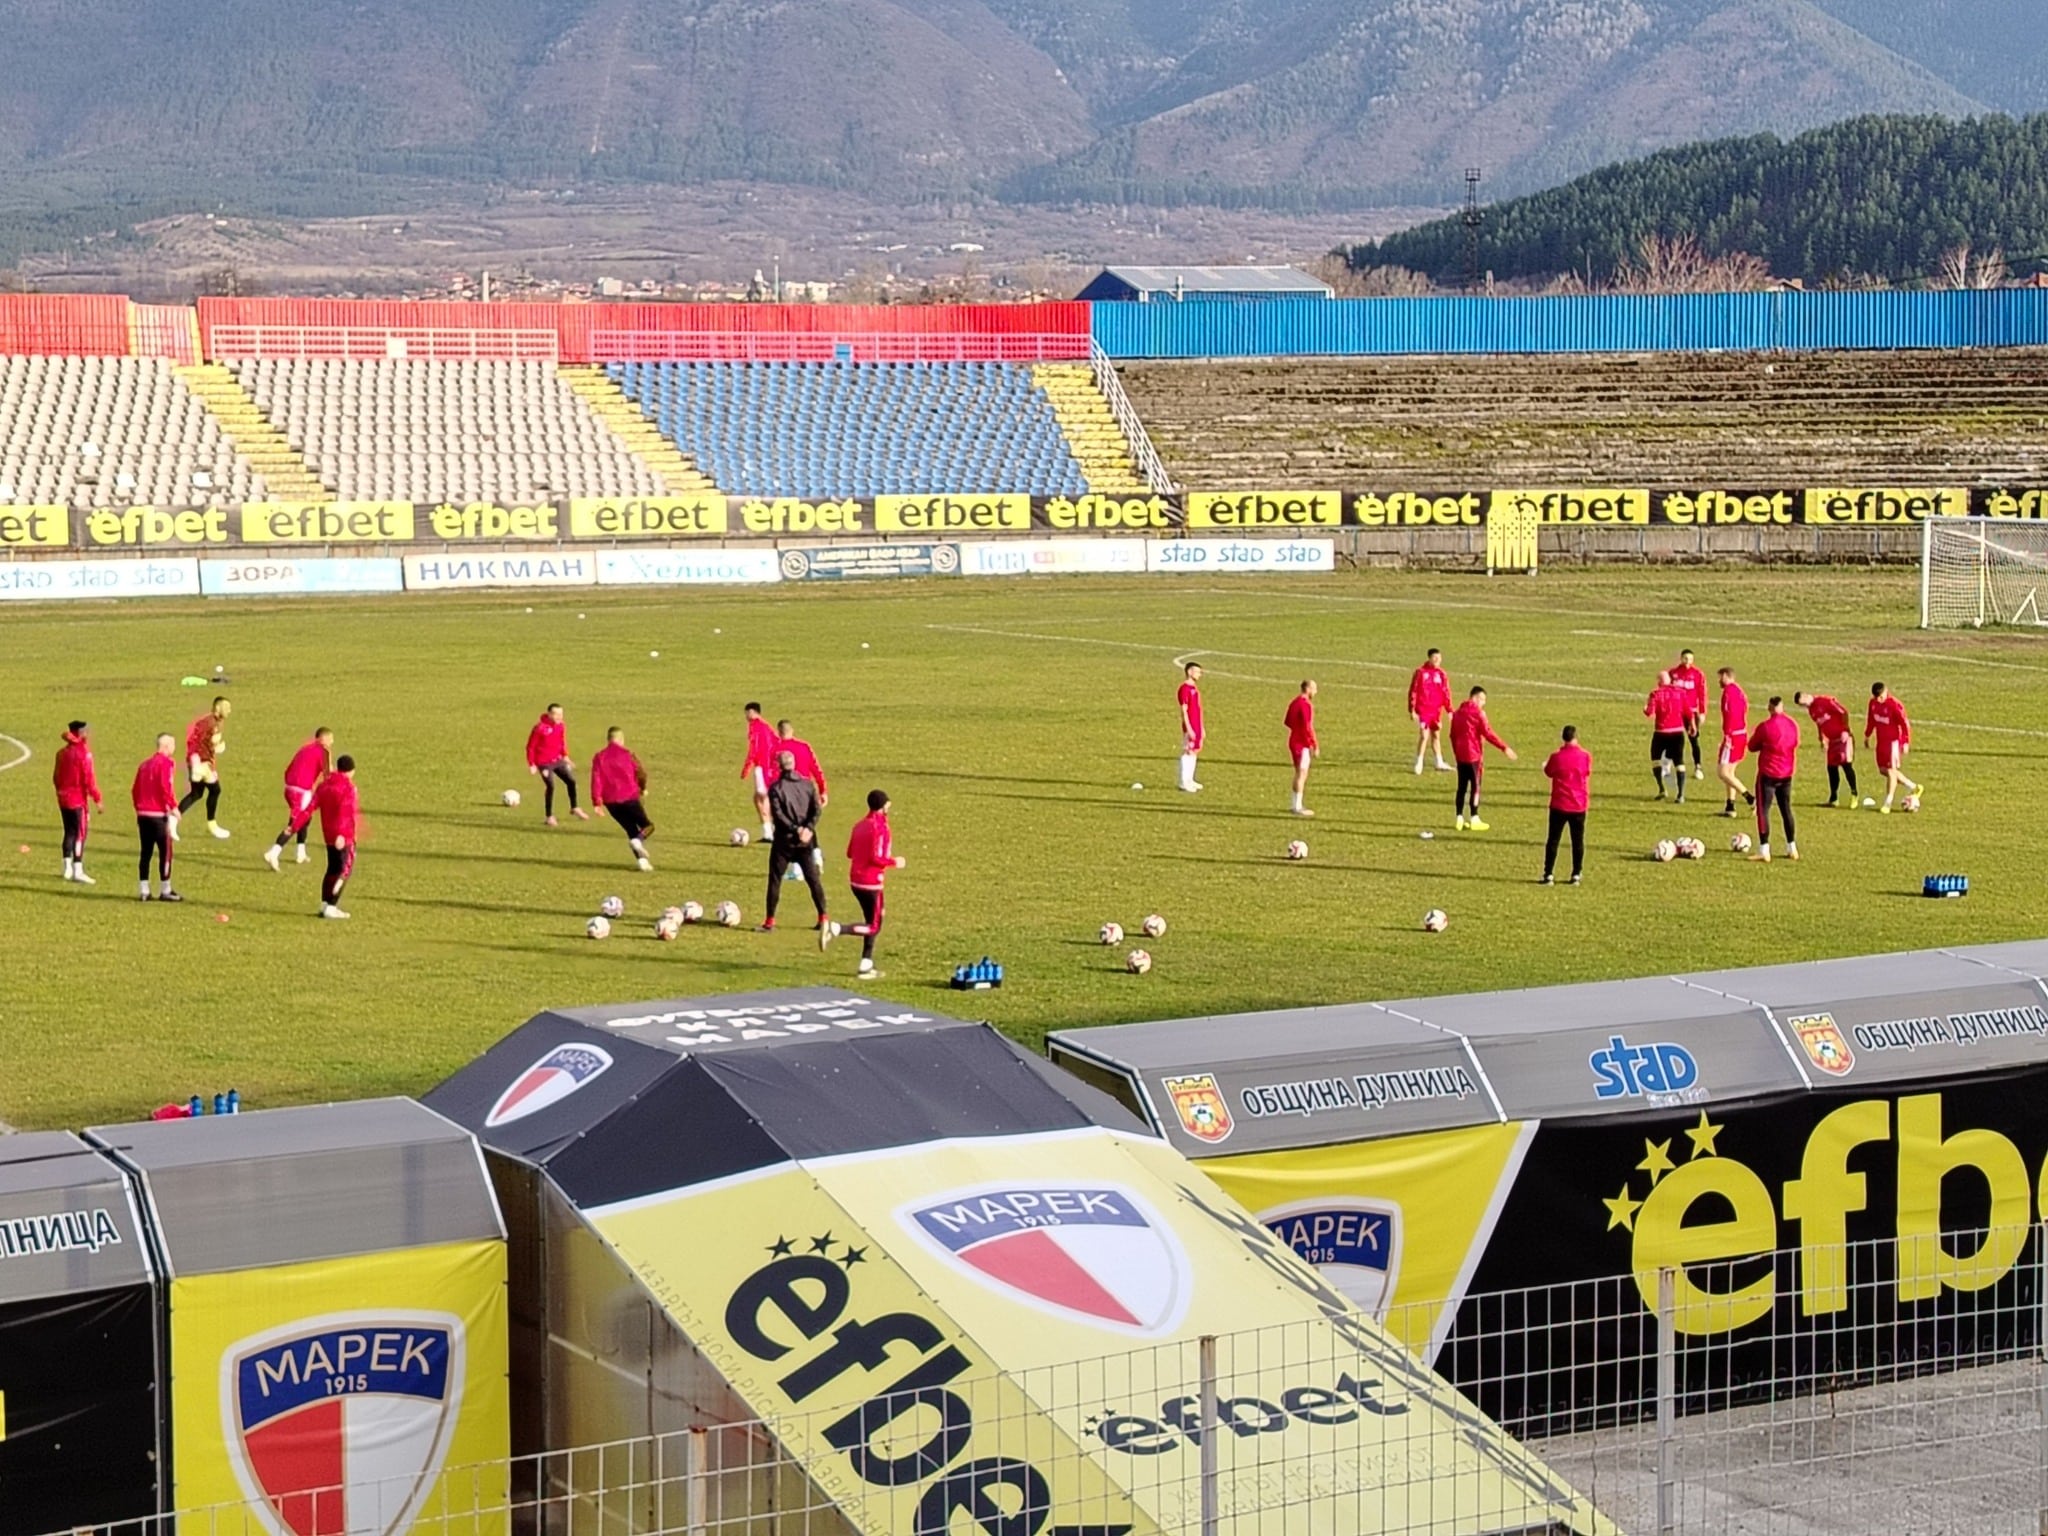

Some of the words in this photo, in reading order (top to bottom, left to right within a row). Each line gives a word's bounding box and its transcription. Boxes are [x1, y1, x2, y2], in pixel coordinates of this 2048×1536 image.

[268, 505, 395, 538] efbet
[432, 503, 558, 538] efbet
[595, 500, 709, 532] efbet
[743, 498, 862, 532] efbet
[899, 497, 1013, 527] efbet
[1048, 494, 1169, 528] efbet
[1208, 495, 1327, 524] efbet
[1356, 492, 1481, 525] efbet
[1664, 490, 1793, 524] efbet
[1826, 491, 1952, 521] efbet
[88, 506, 228, 544] efbet
[419, 558, 583, 581] НИКМАН
[1853, 1017, 1951, 1053] ОБЩИНА
[1953, 1006, 2048, 1047] ДУПНИЦА
[1241, 1075, 1353, 1118] ОБЩИНА
[1359, 1065, 1478, 1111] ДУПНИЦА
[931, 1188, 1121, 1234] МАРЕК
[1013, 1213, 1062, 1229] 1915
[1631, 1093, 2048, 1336] efb
[1303, 1247, 1336, 1263] 1915
[255, 1332, 436, 1398] МАРЕК
[324, 1373, 368, 1395] 1915
[725, 1255, 1133, 1536] efbe
